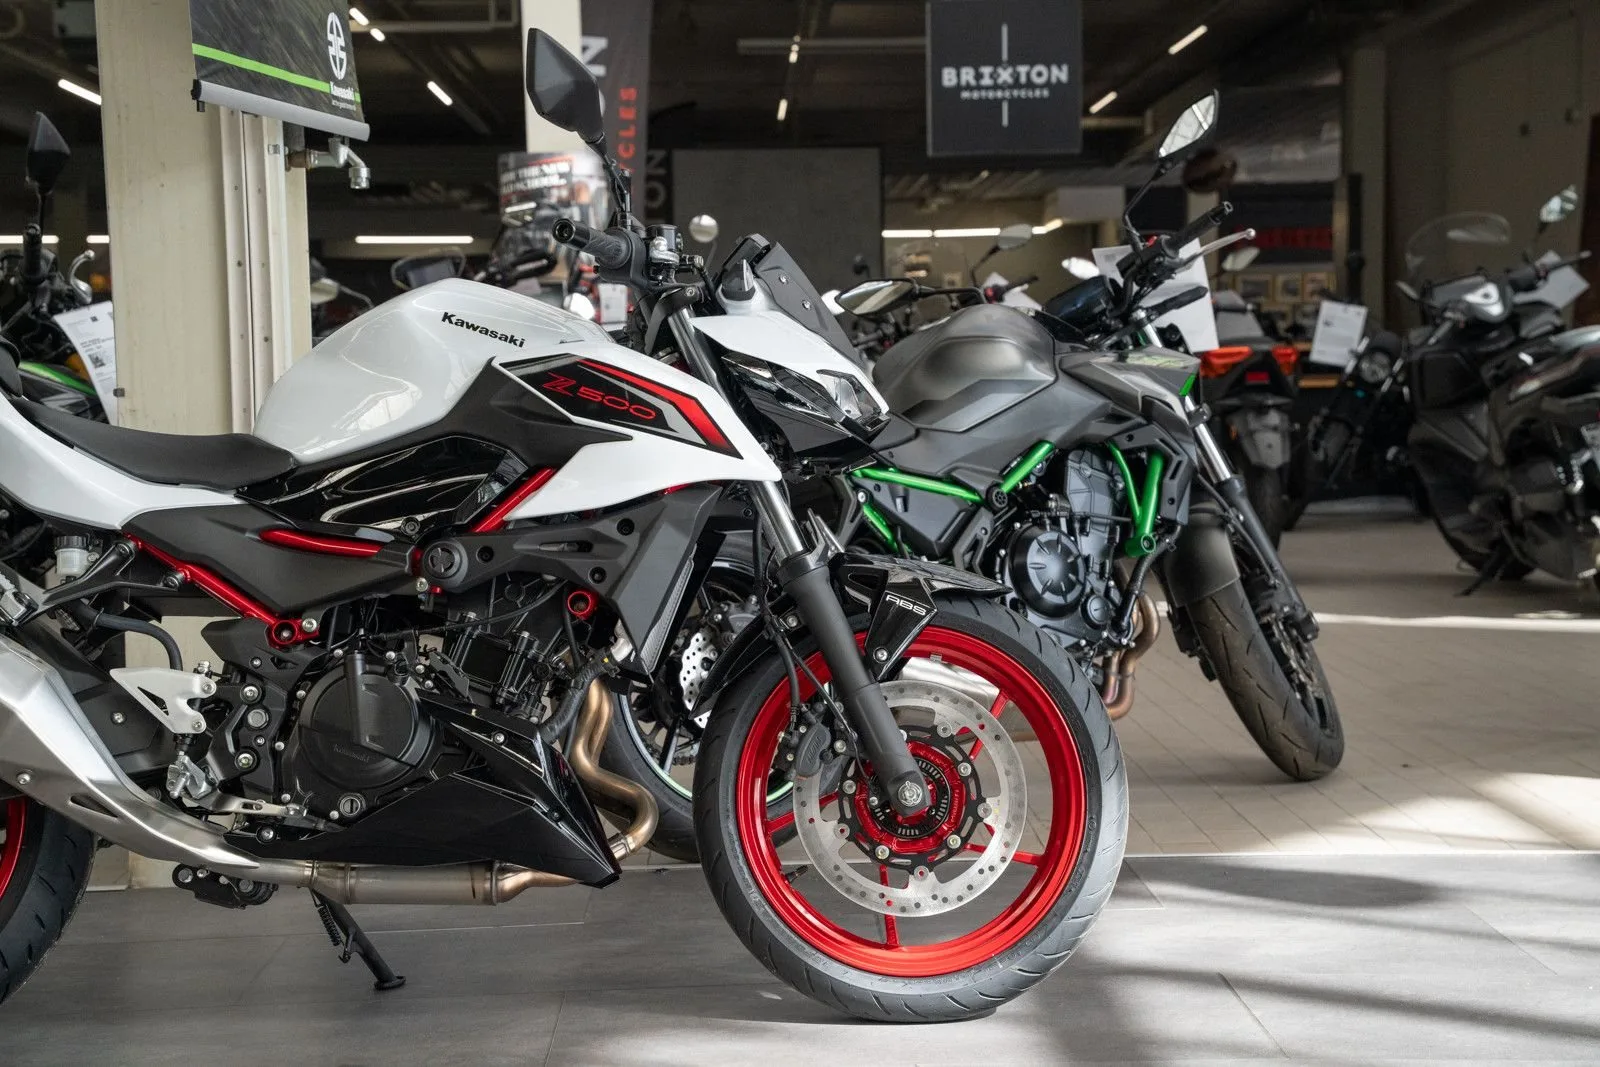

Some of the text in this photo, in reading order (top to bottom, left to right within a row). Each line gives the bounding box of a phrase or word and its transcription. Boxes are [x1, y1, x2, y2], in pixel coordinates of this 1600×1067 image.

[941, 64, 1069, 88] BRIXTON
[960, 88, 1050, 100] MOTORCYCLES
[441, 311, 526, 348] Kawasaki
[885, 594, 927, 616] ABS
